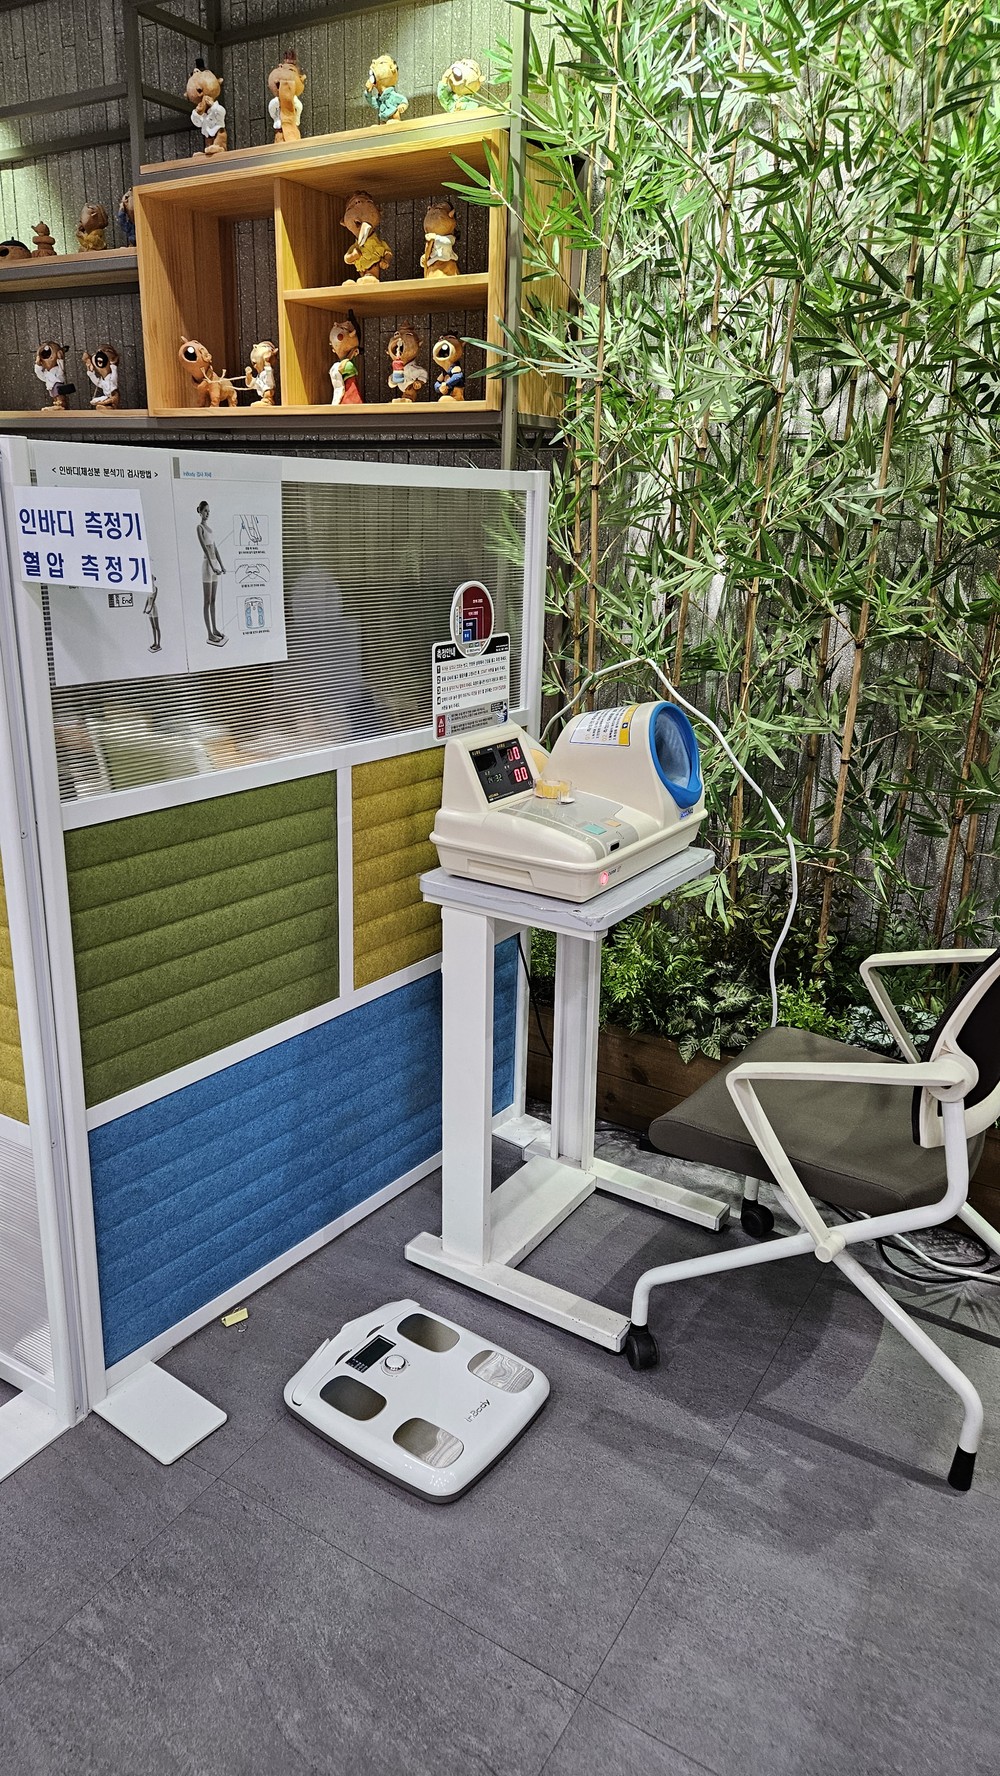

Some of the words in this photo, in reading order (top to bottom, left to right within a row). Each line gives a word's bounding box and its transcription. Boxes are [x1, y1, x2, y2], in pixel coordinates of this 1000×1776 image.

[19, 508, 75, 537] 인바디
[84, 511, 143, 541] 측정기
[22, 550, 65, 579] 혈압
[81, 553, 149, 585] 측정기
[436, 646, 456, 659] 측정안내
[513, 766, 529, 783] 00
